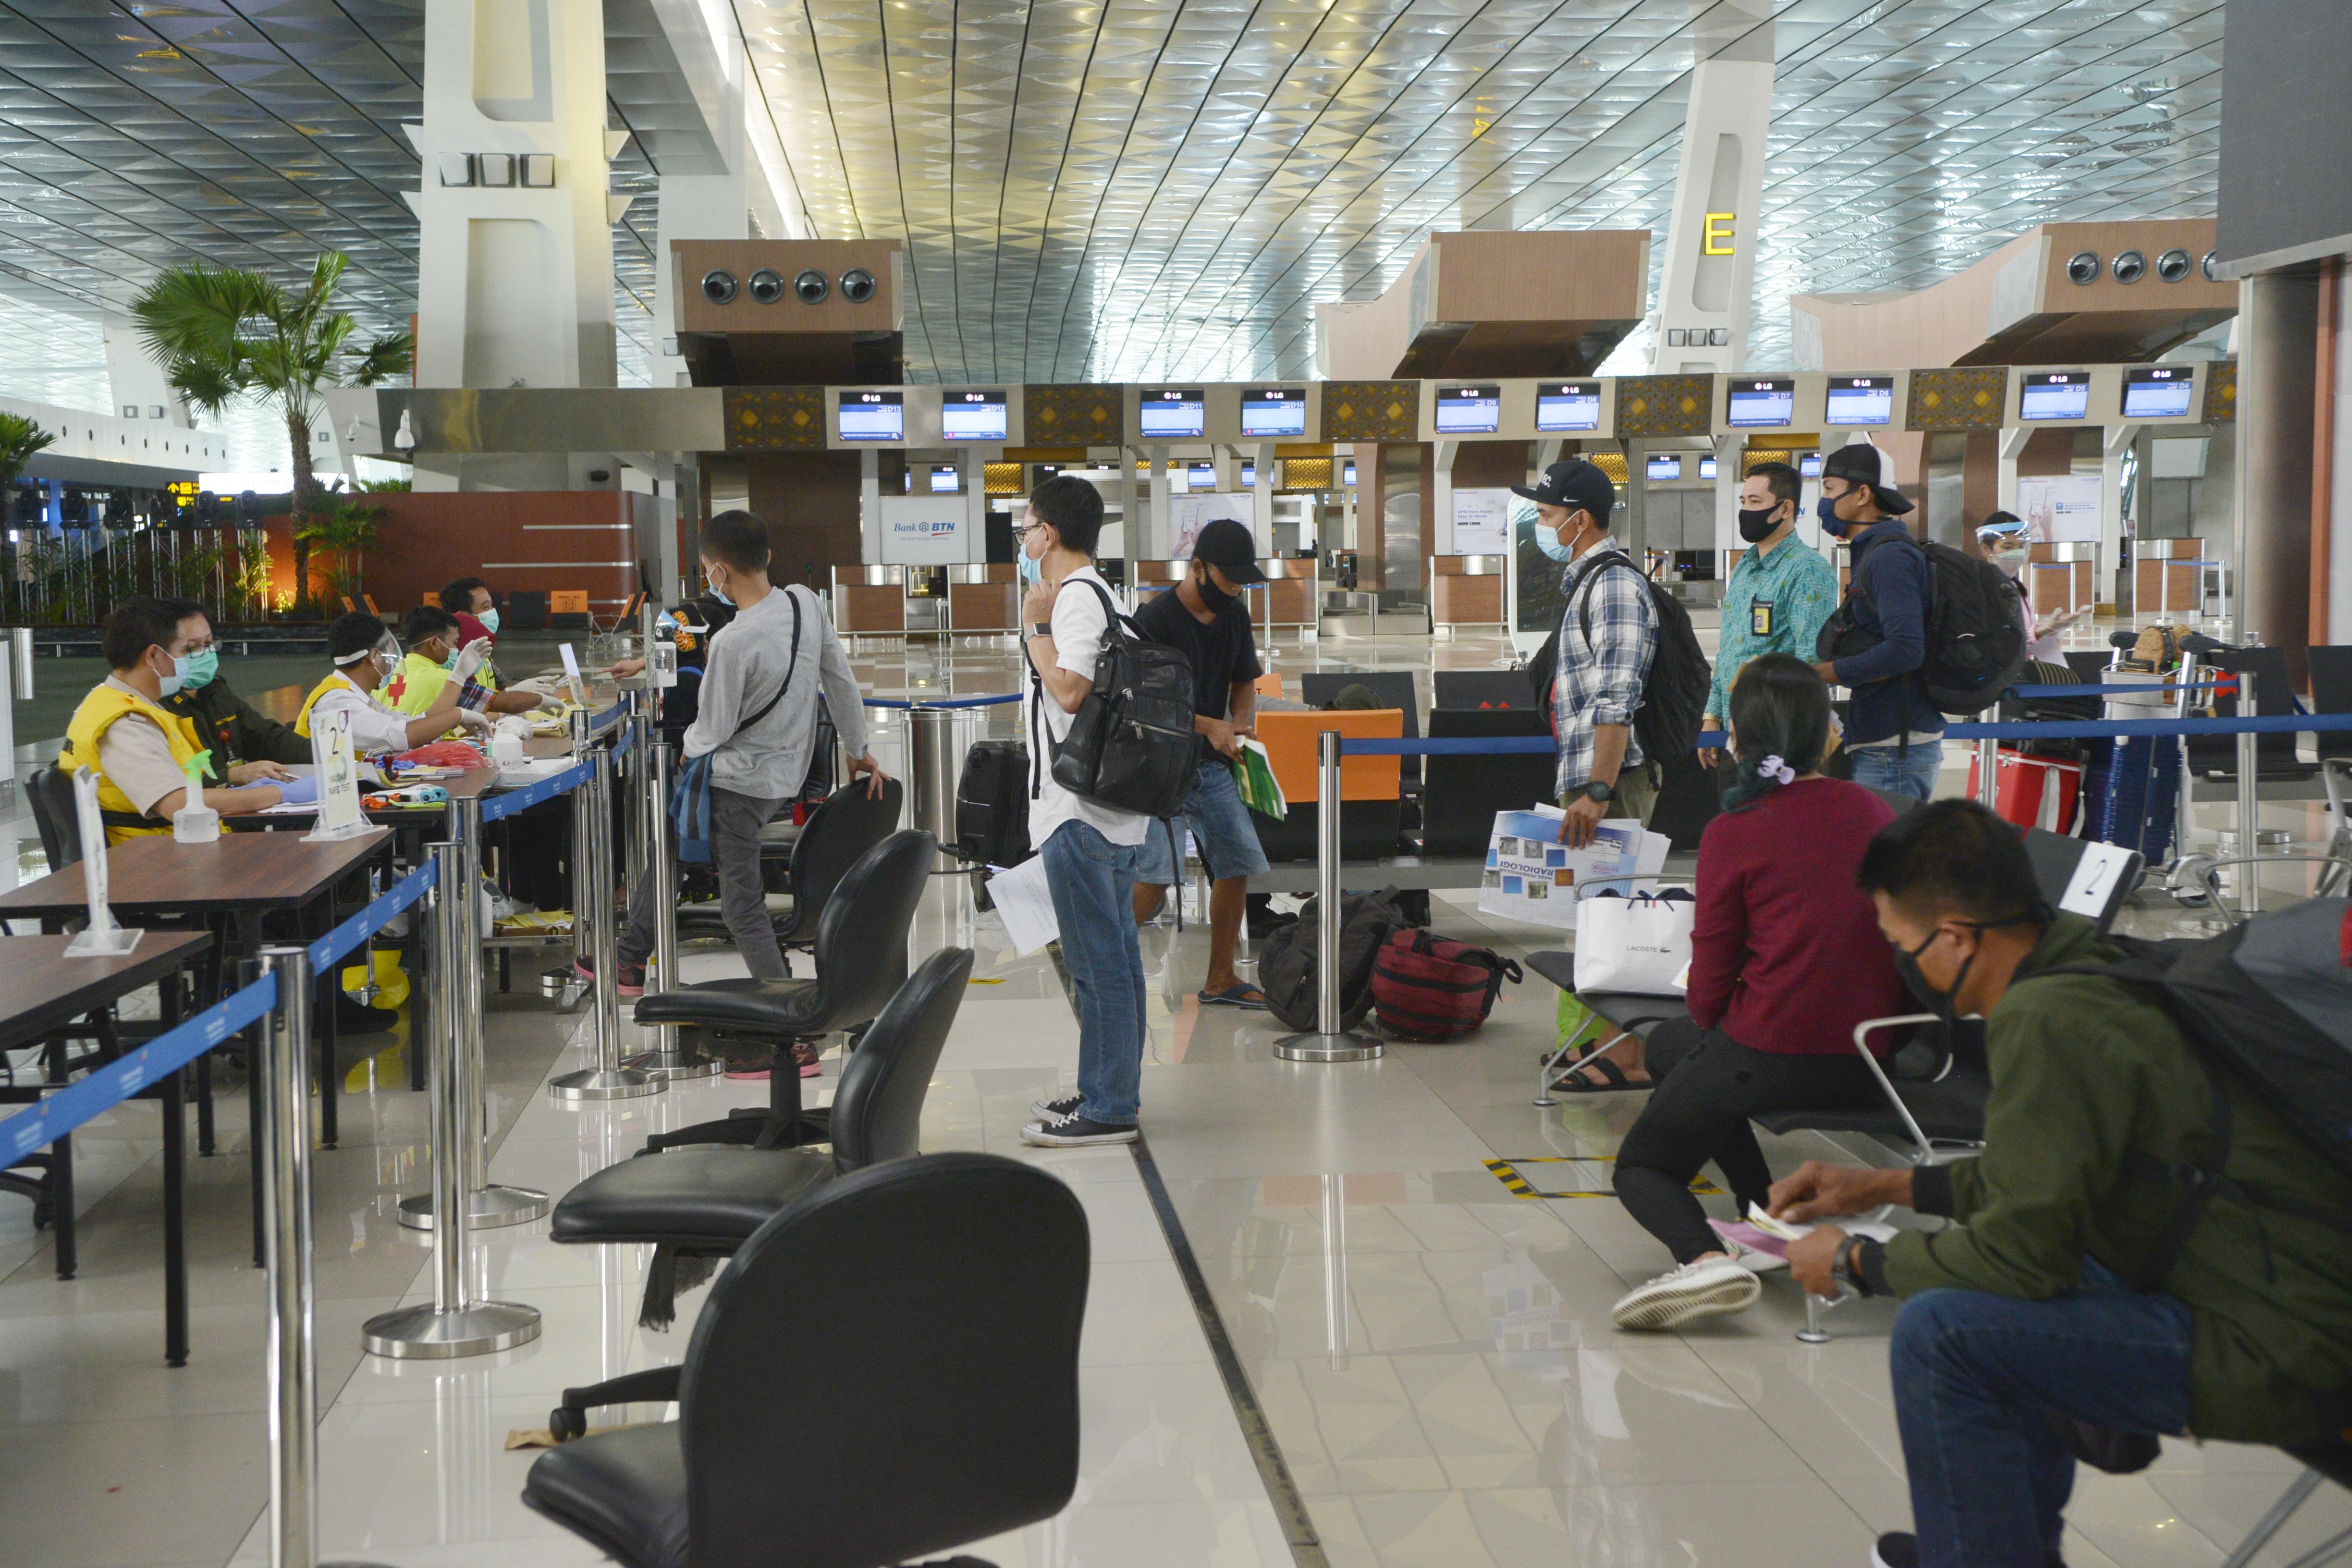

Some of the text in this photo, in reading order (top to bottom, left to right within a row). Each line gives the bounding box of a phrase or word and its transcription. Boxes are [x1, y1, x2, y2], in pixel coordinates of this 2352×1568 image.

[1705, 213, 1735, 255] E
[894, 522, 955, 532] Bank BTN
[330, 727, 338, 755] 2
[340, 782, 350, 792] TEST
[1500, 861, 1553, 876] RADIOLOGI
